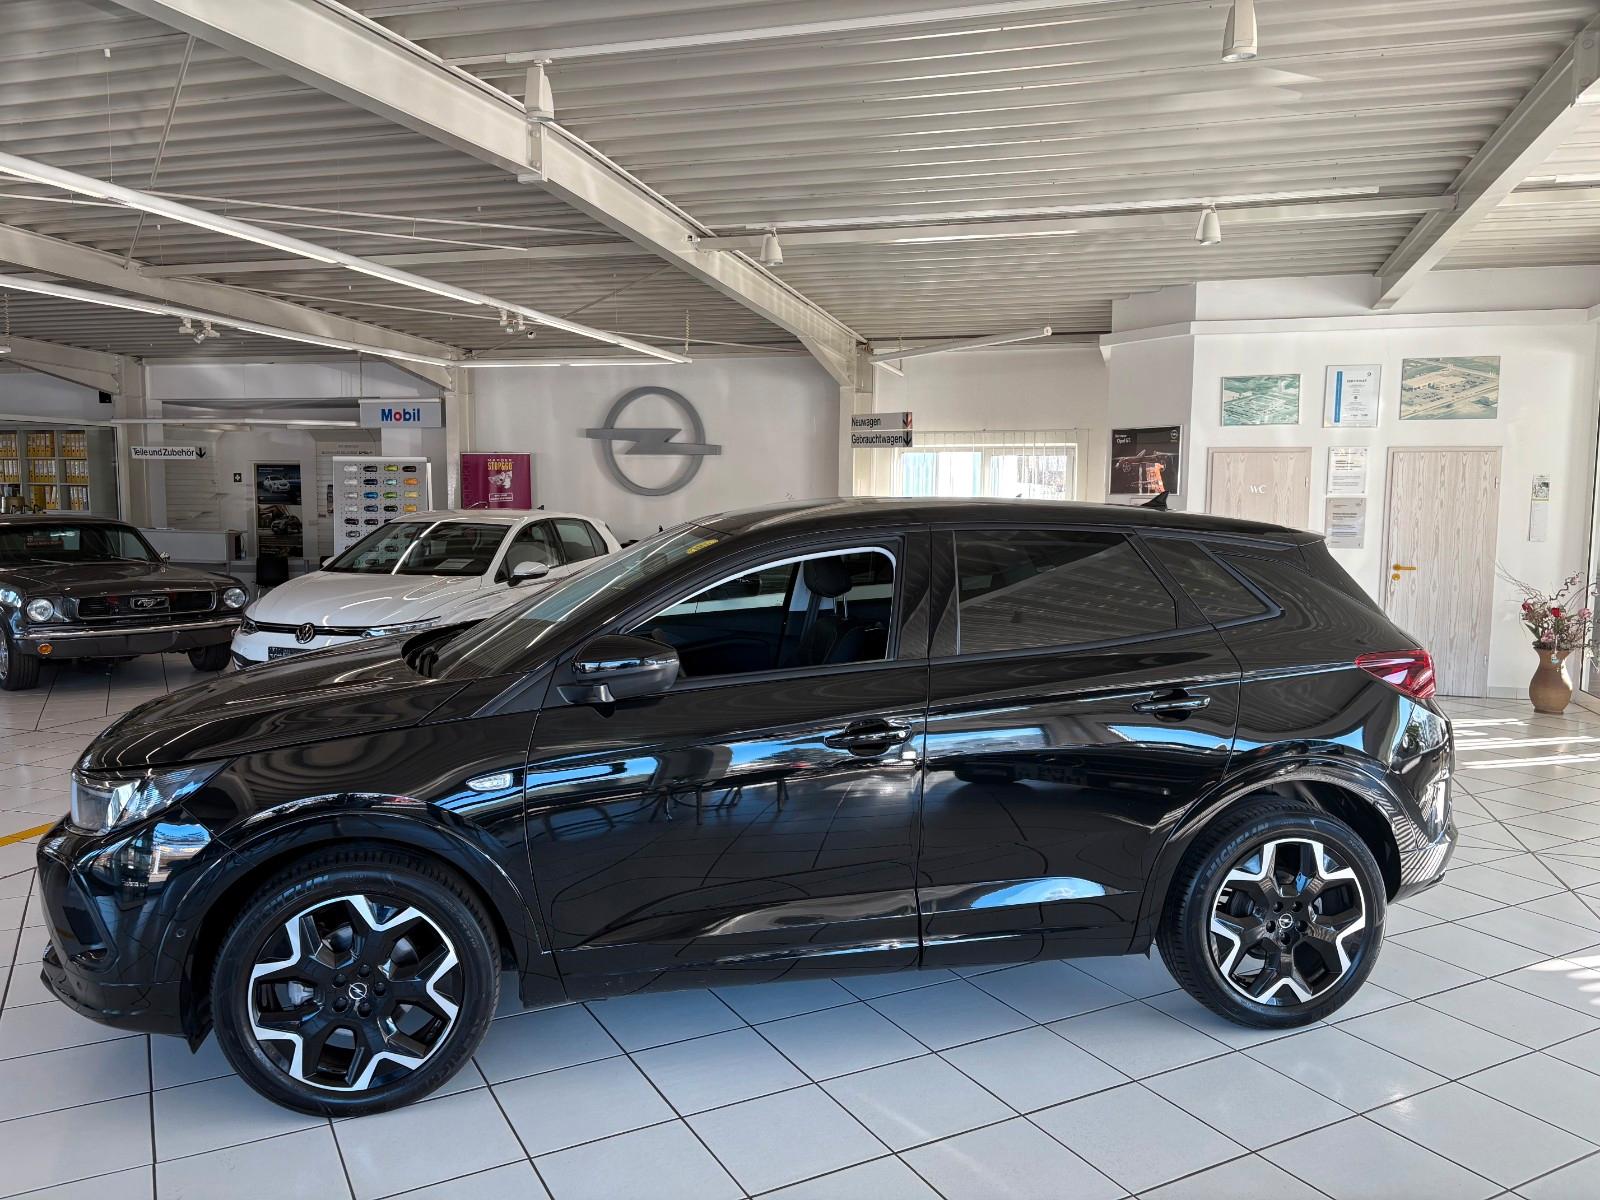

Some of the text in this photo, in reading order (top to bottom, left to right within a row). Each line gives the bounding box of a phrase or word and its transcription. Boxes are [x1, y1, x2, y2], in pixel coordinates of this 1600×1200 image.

[381, 408, 421, 422] Mobil
[851, 417, 881, 428] Neuwagen
[851, 434, 903, 446] Gebrauchtwagen
[132, 447, 195, 457] Teile und Zubehör
[1248, 484, 1268, 495] WC
[1206, 822, 1270, 879] MICHELIN
